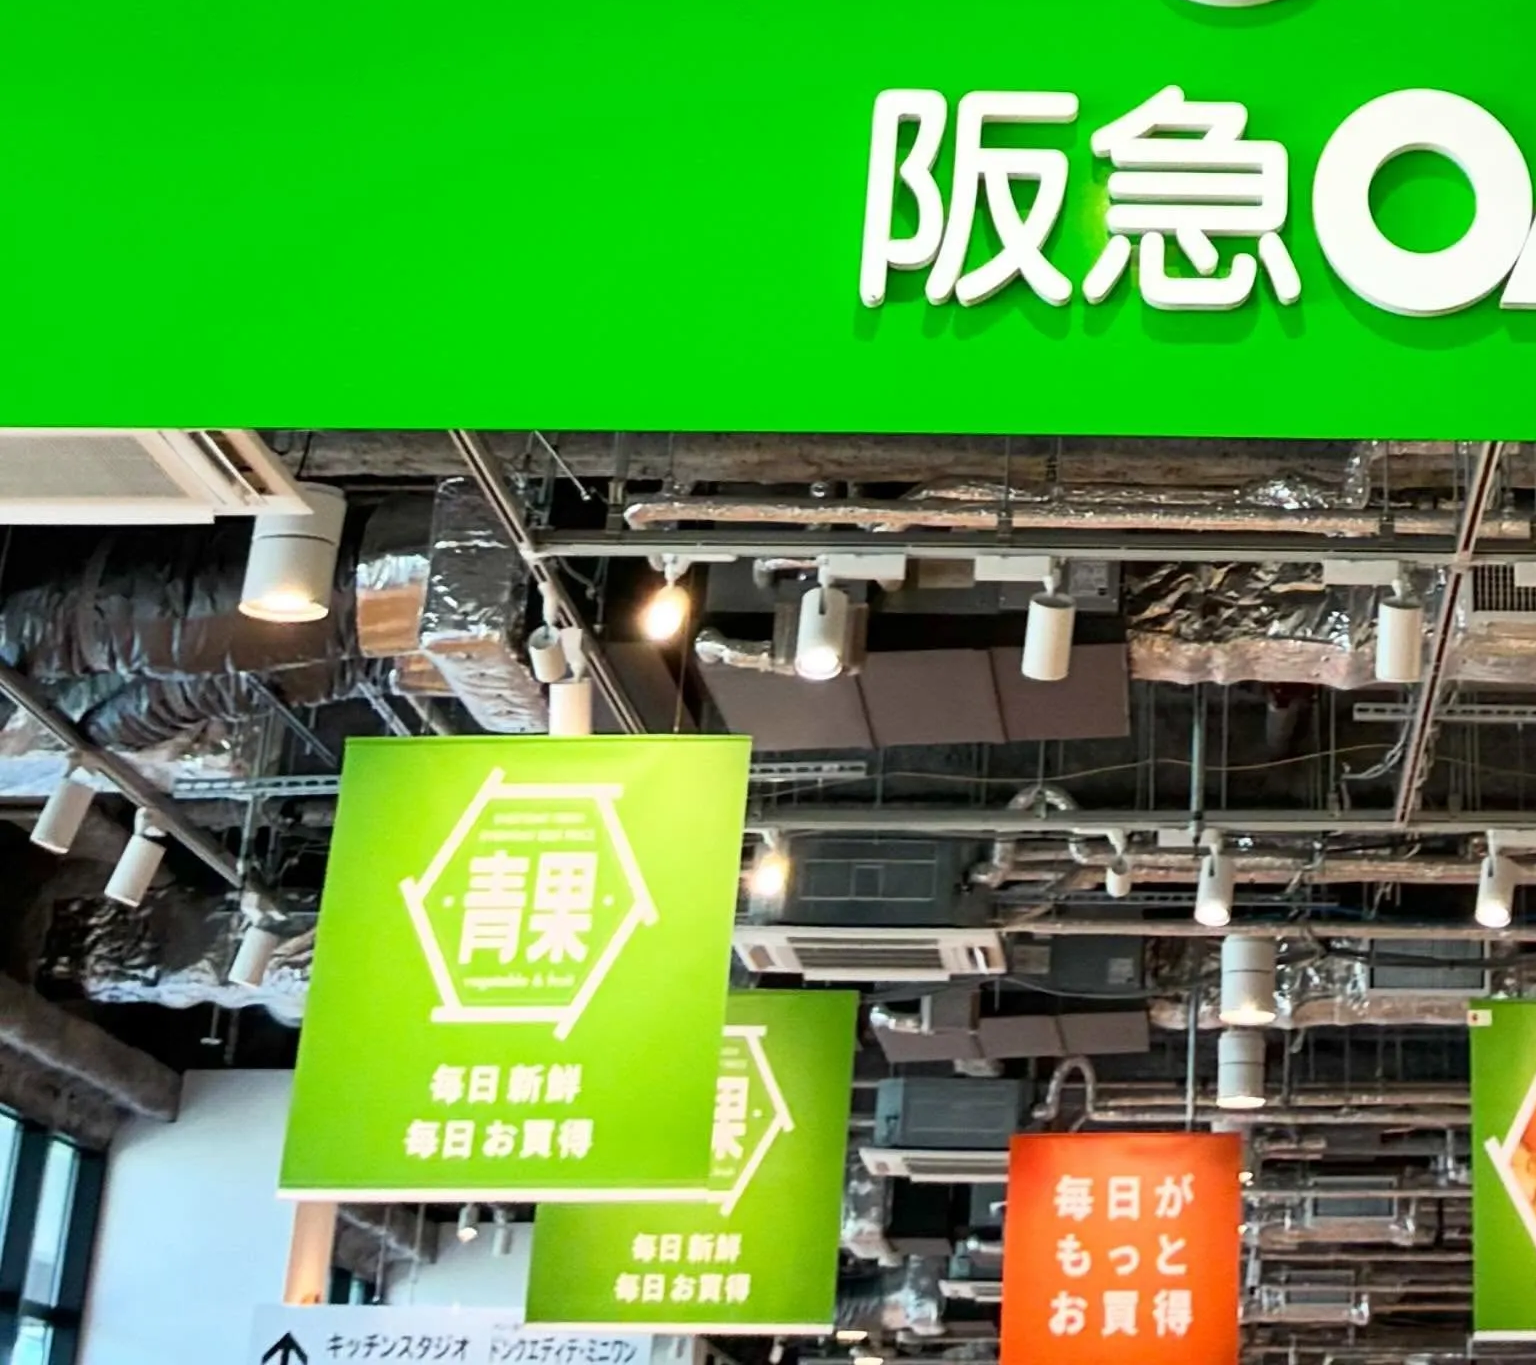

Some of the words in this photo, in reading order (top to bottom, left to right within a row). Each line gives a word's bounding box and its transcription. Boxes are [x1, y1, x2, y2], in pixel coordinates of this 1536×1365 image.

[458, 850, 598, 965] 青果
[429, 1063, 583, 1105] 毎日新鮮
[402, 1119, 594, 1159] 毎日お買得
[712, 1076, 749, 1161] 果
[1053, 1172, 1196, 1222] 毎日が
[1056, 1233, 1188, 1278] もっと
[1048, 1288, 1195, 1339] お買得
[326, 1332, 470, 1361] キッチンスタジオ
